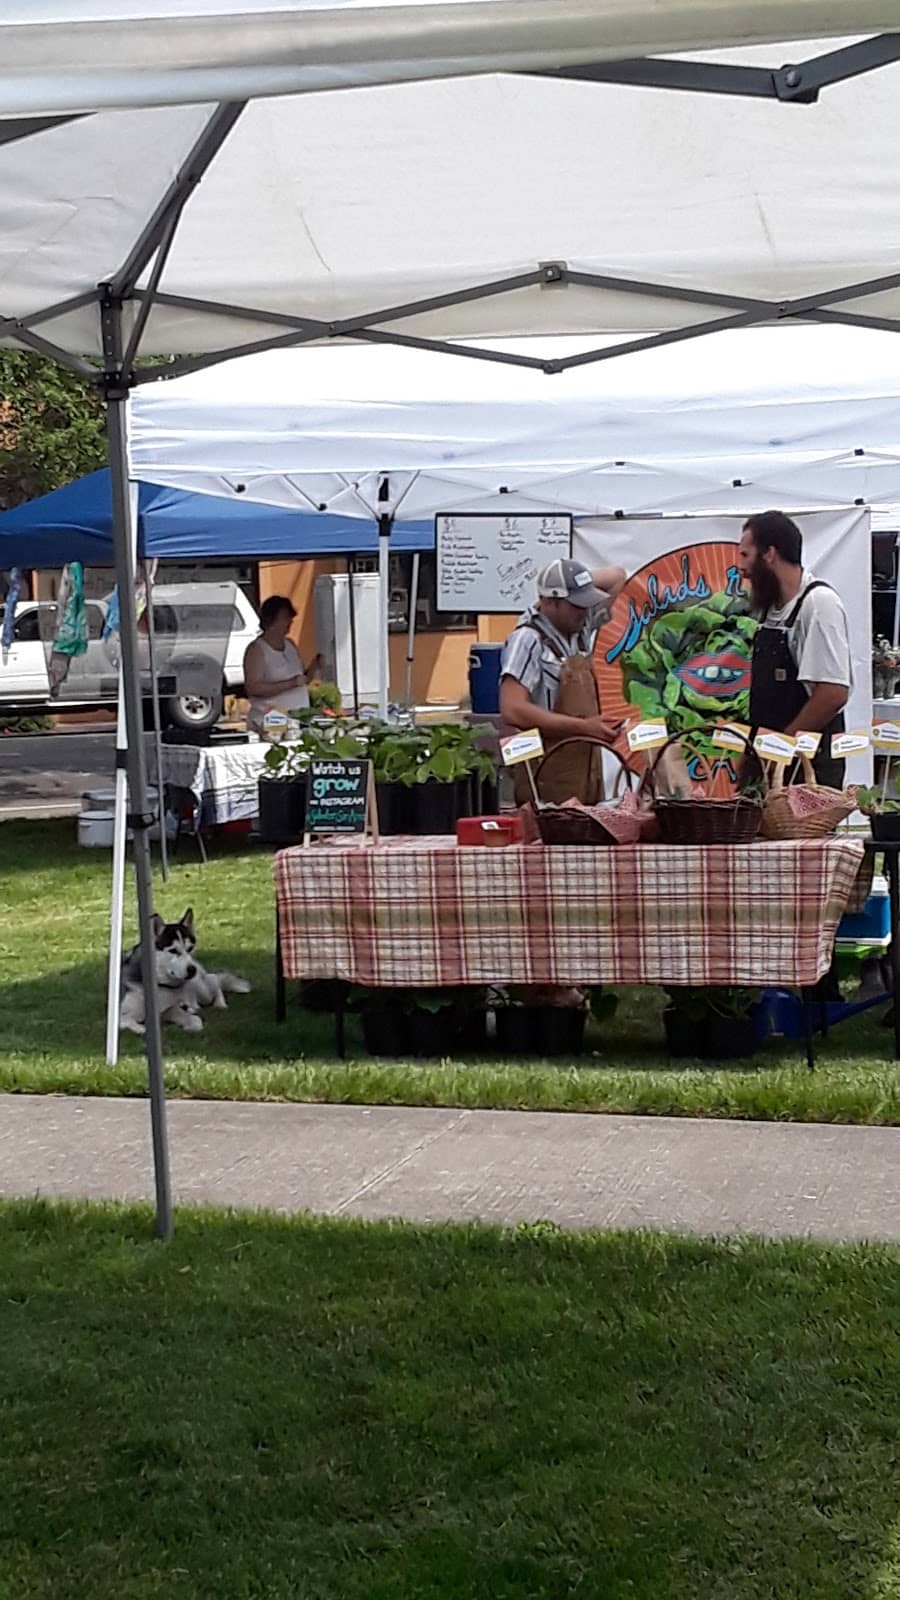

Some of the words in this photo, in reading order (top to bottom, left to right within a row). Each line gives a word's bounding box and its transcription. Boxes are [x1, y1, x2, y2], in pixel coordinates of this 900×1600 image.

[312, 762, 345, 775] Watch
[348, 766, 361, 775] us
[313, 778, 360, 798] grow
